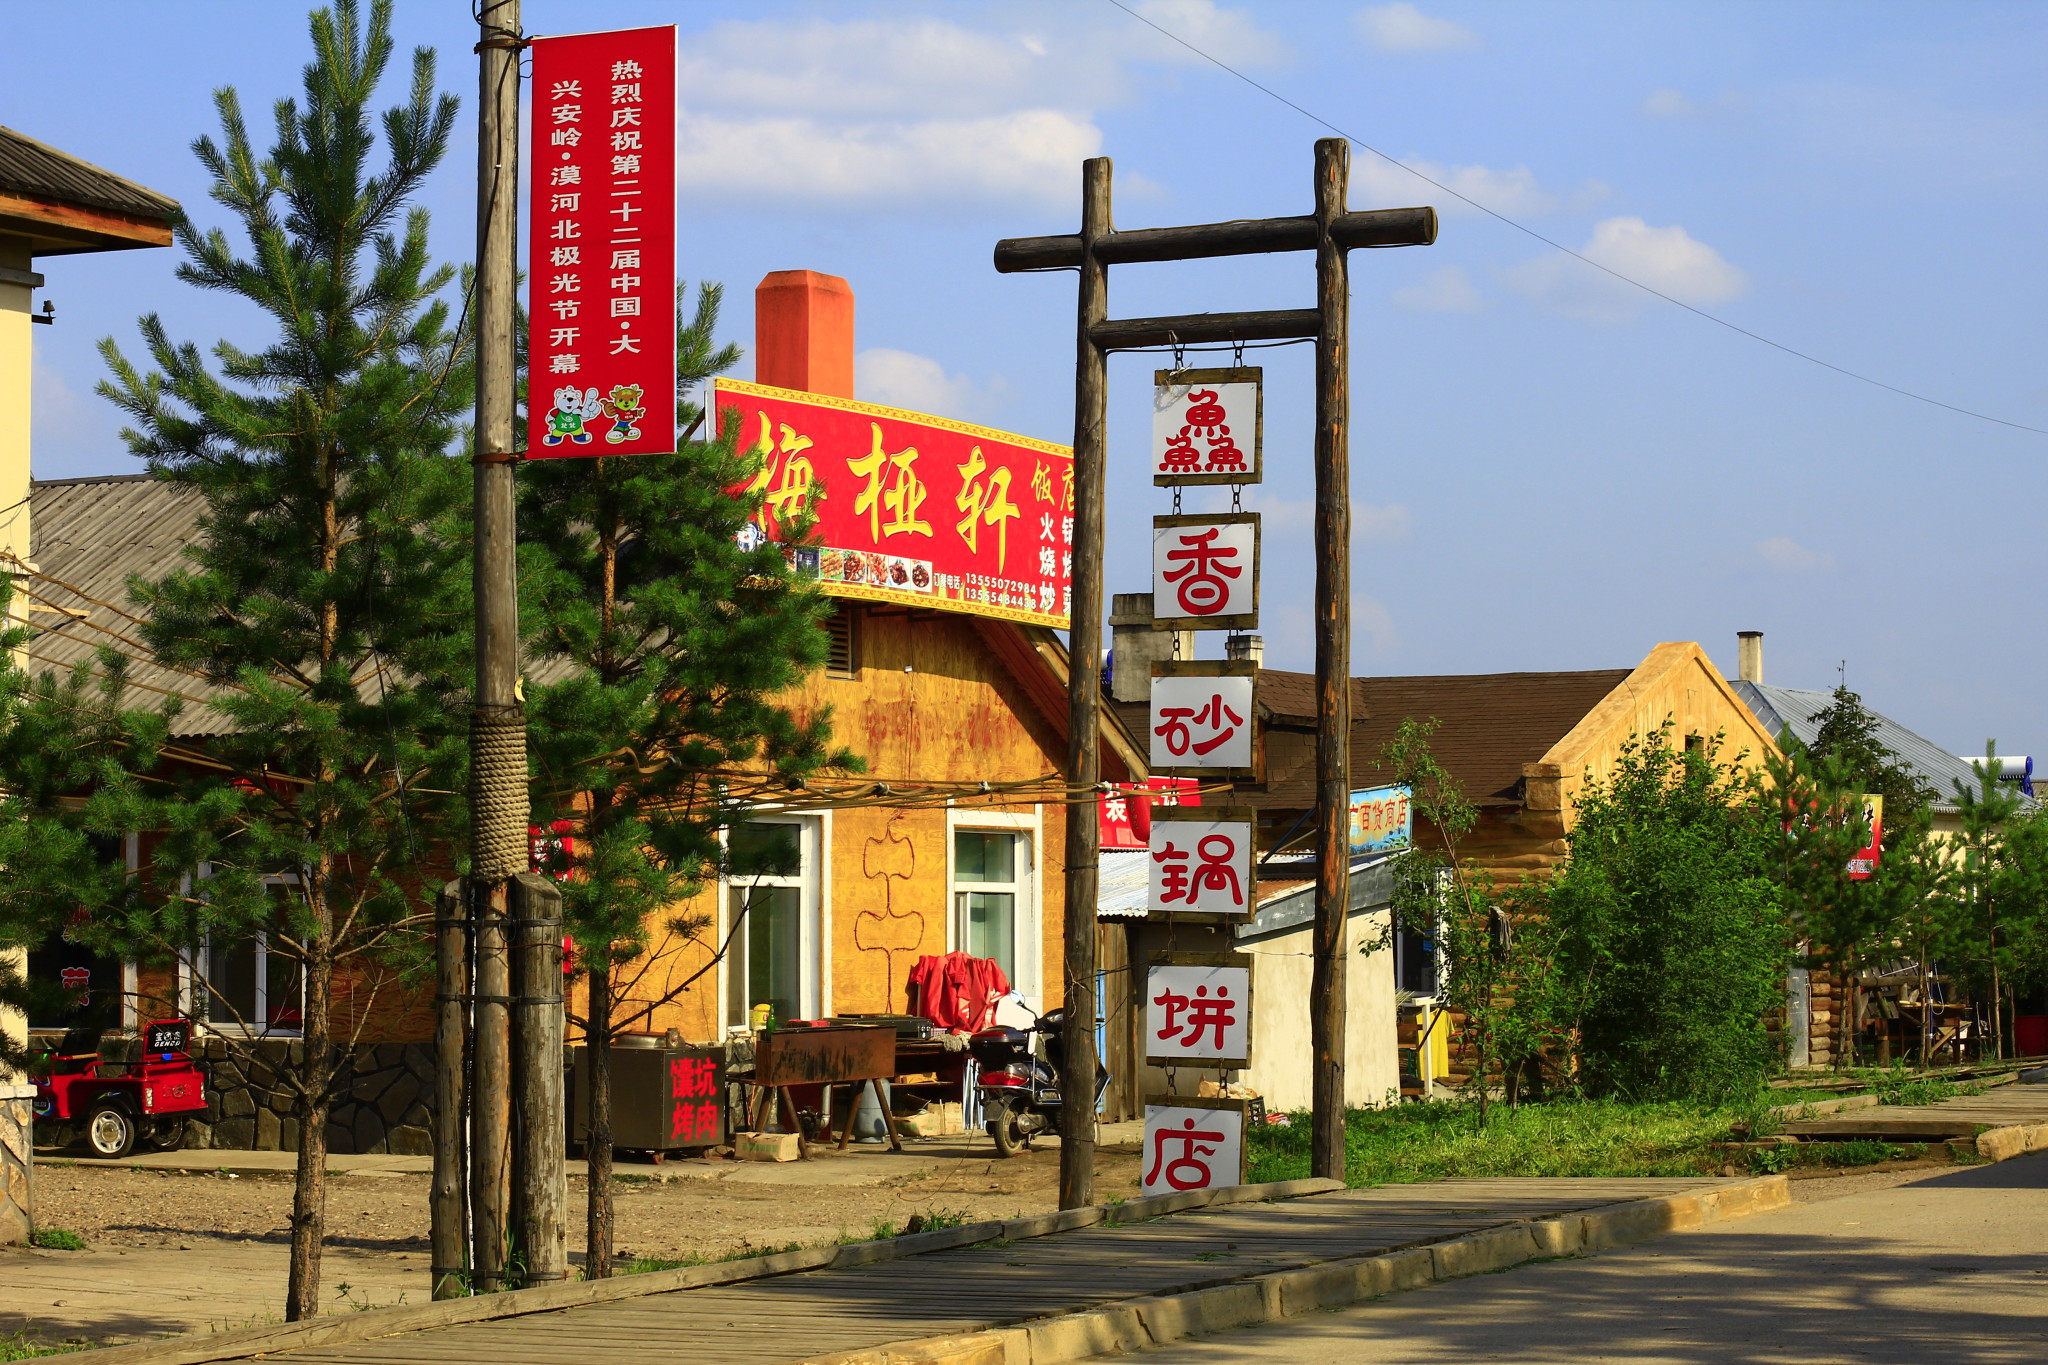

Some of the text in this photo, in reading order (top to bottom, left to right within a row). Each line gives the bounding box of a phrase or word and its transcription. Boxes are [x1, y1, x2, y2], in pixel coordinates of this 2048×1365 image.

[965, 573, 1037, 595] 13555072984
[965, 588, 1037, 610] 13555484438
[1163, 527, 1242, 615] 香
[1154, 694, 1243, 756] 砂
[1152, 834, 1243, 905] 锅
[1153, 985, 1235, 1050] 饼
[671, 1100, 718, 1141] 烤肉
[1145, 1117, 1225, 1190] 店
